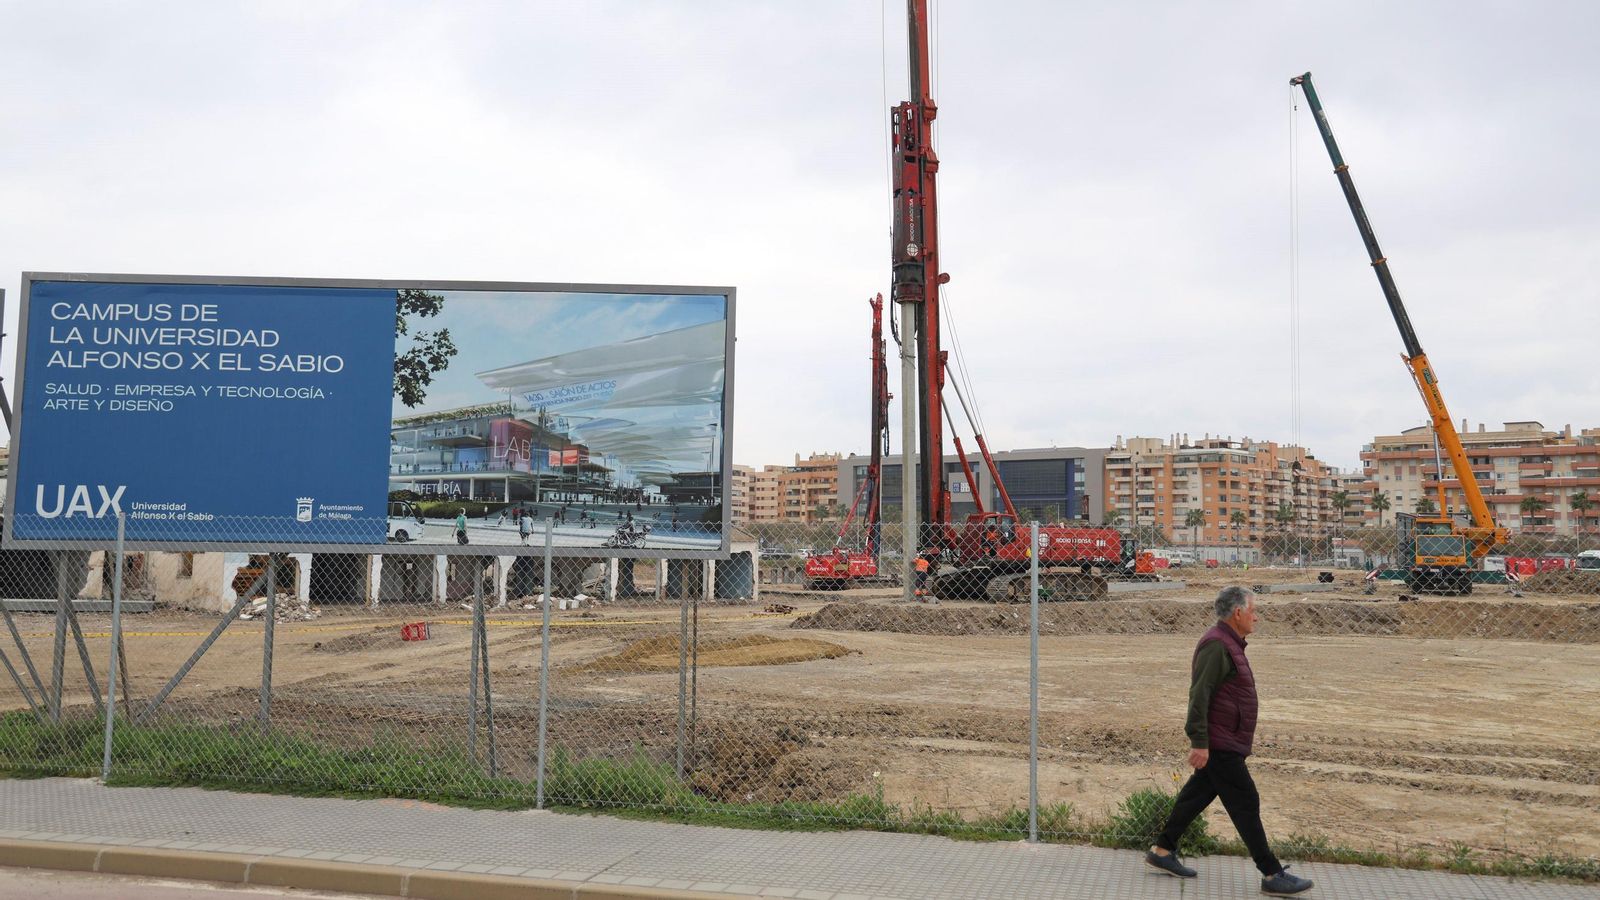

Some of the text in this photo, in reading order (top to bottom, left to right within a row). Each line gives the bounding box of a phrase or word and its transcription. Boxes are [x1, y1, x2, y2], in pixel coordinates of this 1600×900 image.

[51, 302, 218, 322] CAMPUS DE
[49, 327, 279, 348] LA UNIVERSIDAD
[46, 351, 344, 373] ALFONSO X EL SABIO
[45, 383, 324, 399] SALUD EMPRESA Y TECNOLOGÍA
[43, 398, 173, 412] ARTE Y DISEÑO
[494, 435, 531, 461] LAB
[406, 481, 462, 495] AFETRÍA
[36, 484, 126, 519] UAX
[131, 501, 187, 511] Universidad
[319, 503, 363, 512] Ayuntamiento
[131, 511, 214, 521] Alfonso X el Sabio
[328, 511, 352, 521] Málaga
